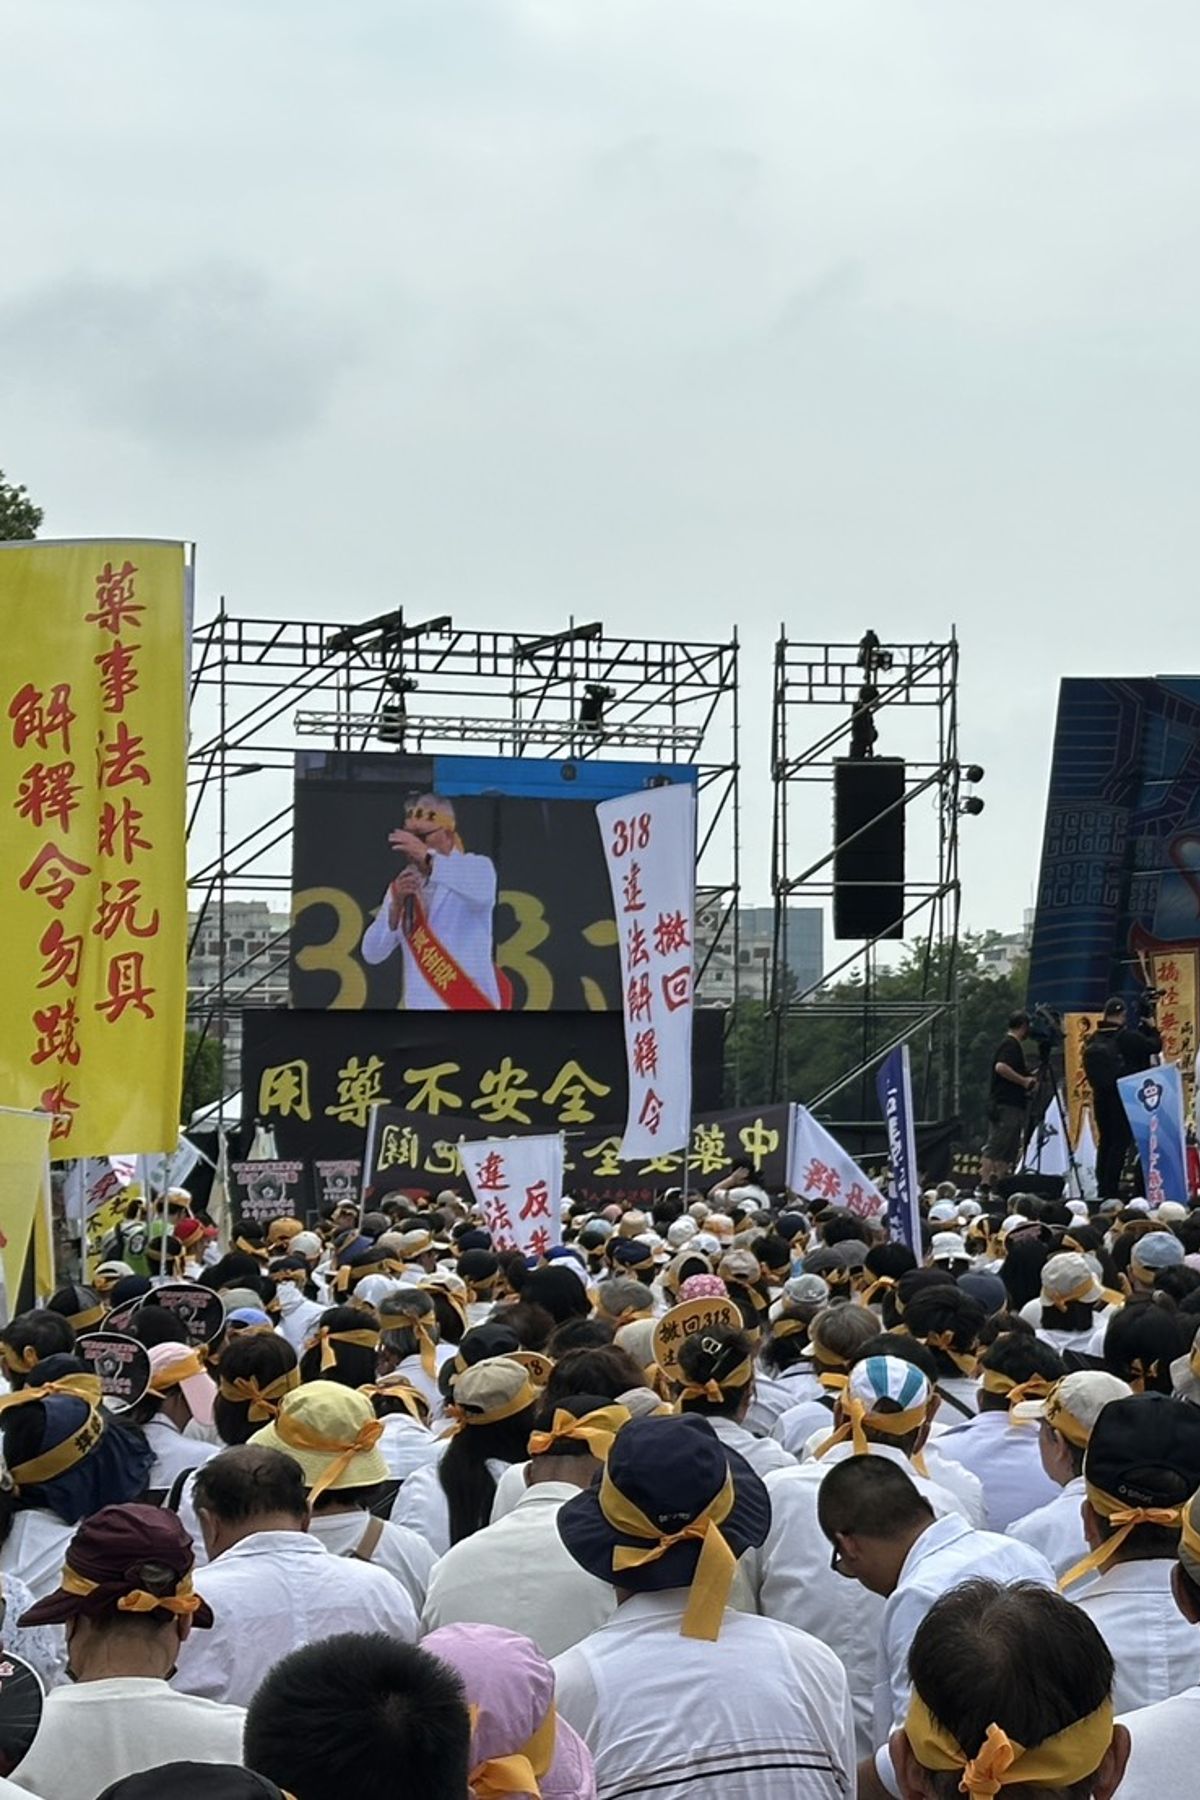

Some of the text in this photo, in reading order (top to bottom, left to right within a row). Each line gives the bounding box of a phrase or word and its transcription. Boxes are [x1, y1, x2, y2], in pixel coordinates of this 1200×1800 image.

[85, 561, 159, 1023] 藥事法非玩具
[653, 910, 692, 1012] 撤回
[258, 1054, 611, 1128] 用藥不安全
